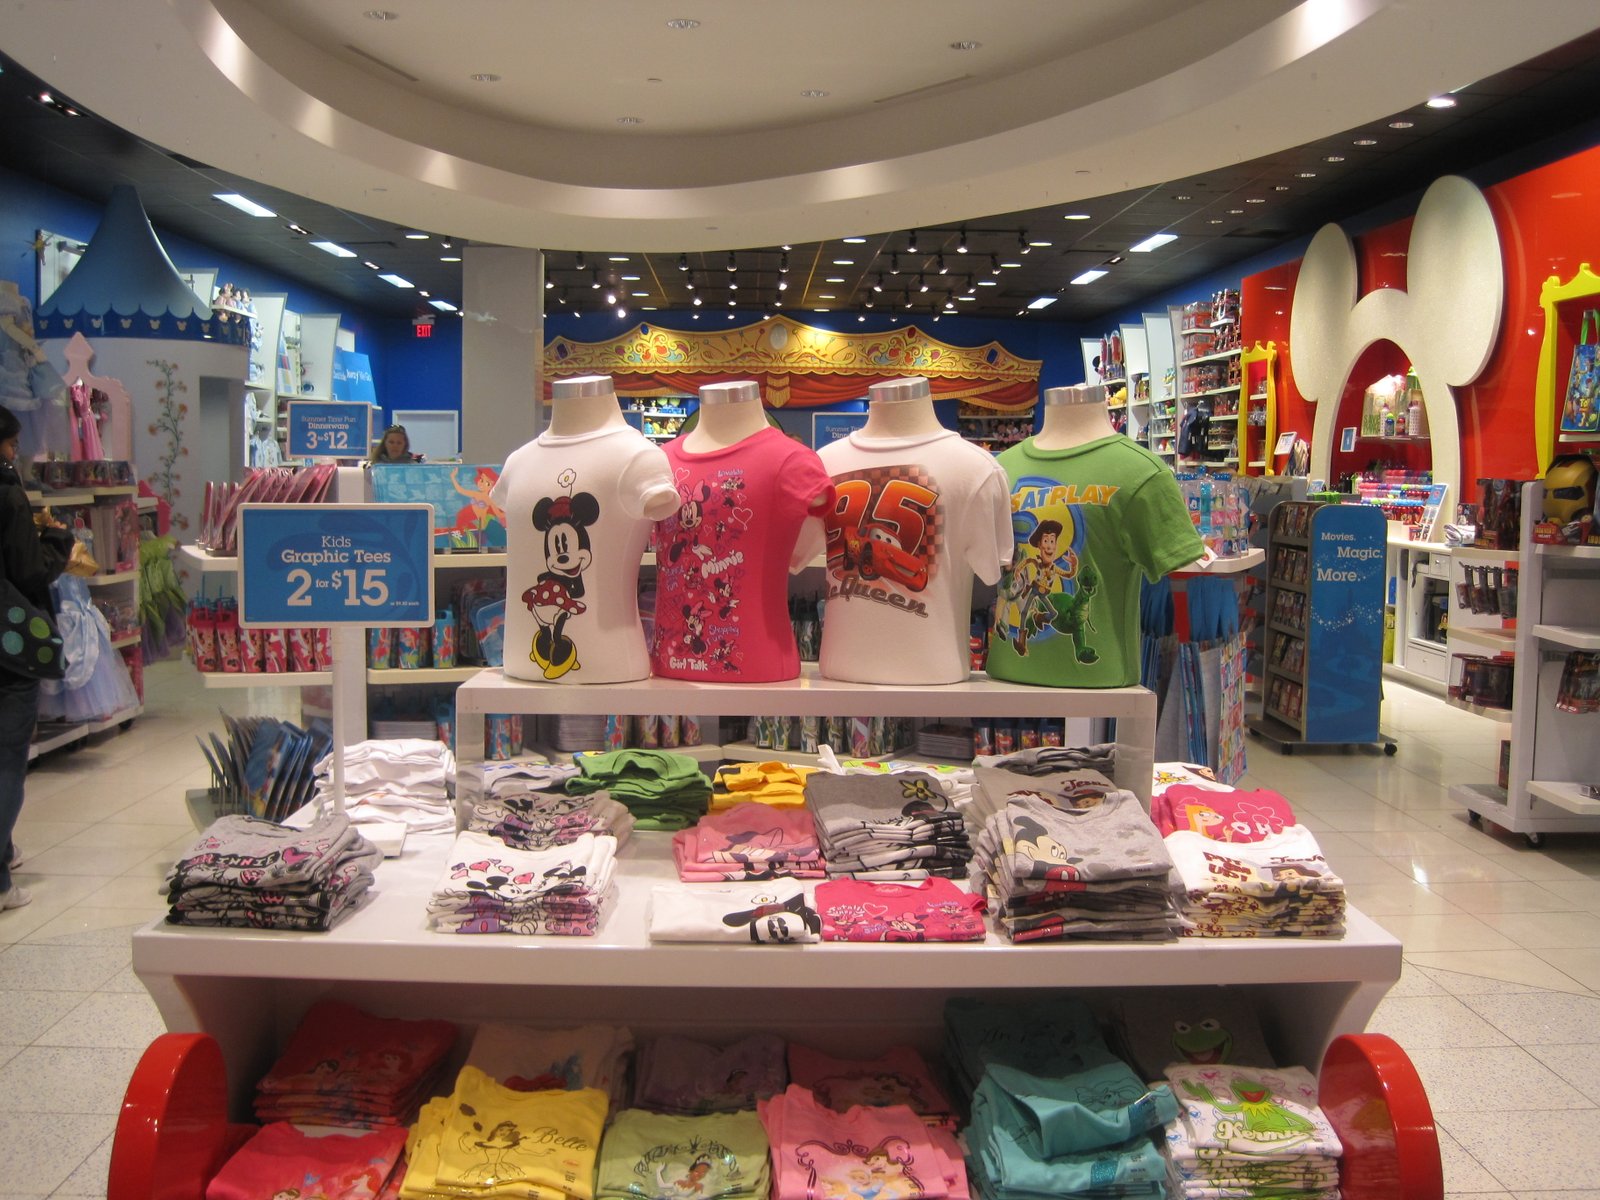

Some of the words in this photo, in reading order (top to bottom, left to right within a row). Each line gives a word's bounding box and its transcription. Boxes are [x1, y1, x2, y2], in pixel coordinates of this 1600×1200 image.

[416, 325, 432, 337] EXIT
[306, 431, 318, 449] 3
[324, 431, 348, 449] $12
[1020, 488, 1051, 511] AT
[1049, 485, 1120, 506] PLAY
[321, 535, 351, 548] Kids
[1321, 532, 1356, 541] Movies.
[281, 550, 349, 566] Graphic
[354, 550, 391, 563] Tees
[1337, 546, 1383, 560] Magic.
[702, 550, 744, 579] Minnie
[1317, 568, 1361, 581] More.
[286, 568, 312, 606] 2
[316, 578, 329, 588] for
[331, 569, 389, 606] $15
[669, 656, 687, 669] Girl
[687, 658, 708, 671] Talk
[533, 1126, 588, 1151] Belle
